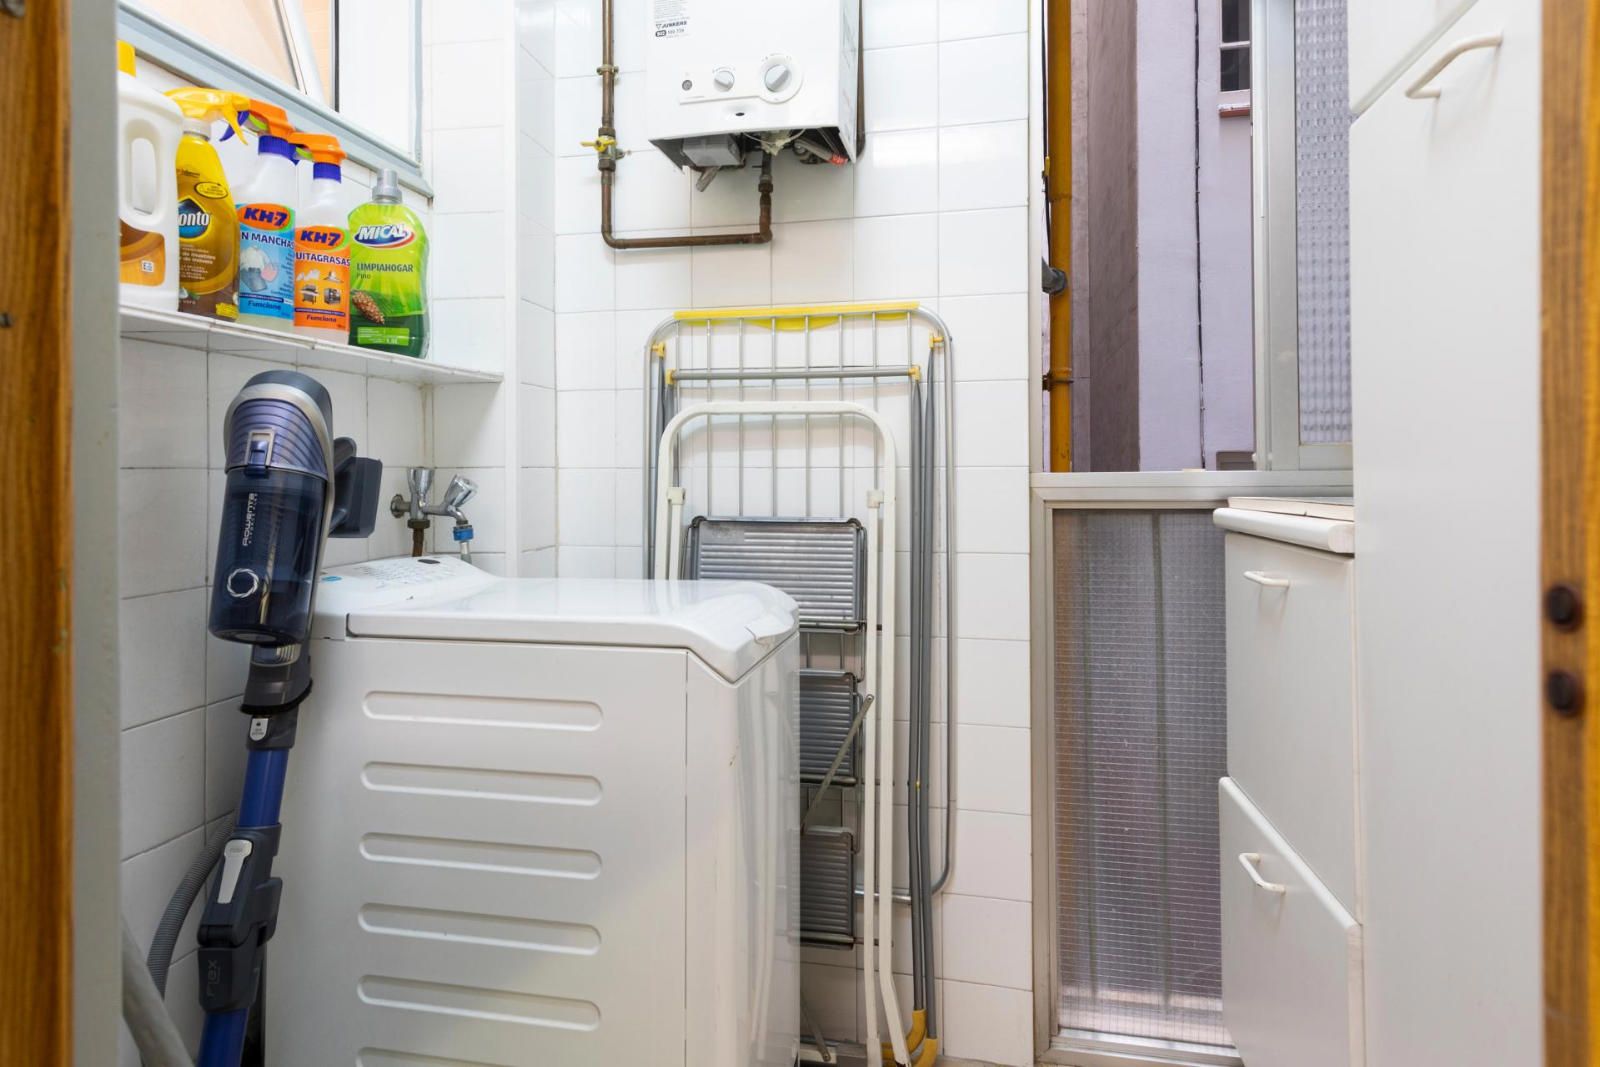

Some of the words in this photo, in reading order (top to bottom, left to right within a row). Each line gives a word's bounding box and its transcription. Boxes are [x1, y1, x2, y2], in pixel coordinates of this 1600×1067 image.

[178, 211, 210, 226] onto
[358, 224, 407, 240] MICAL
[295, 251, 351, 267] UITAGRASAS
[356, 262, 414, 273] LIMPIAHOGAR
